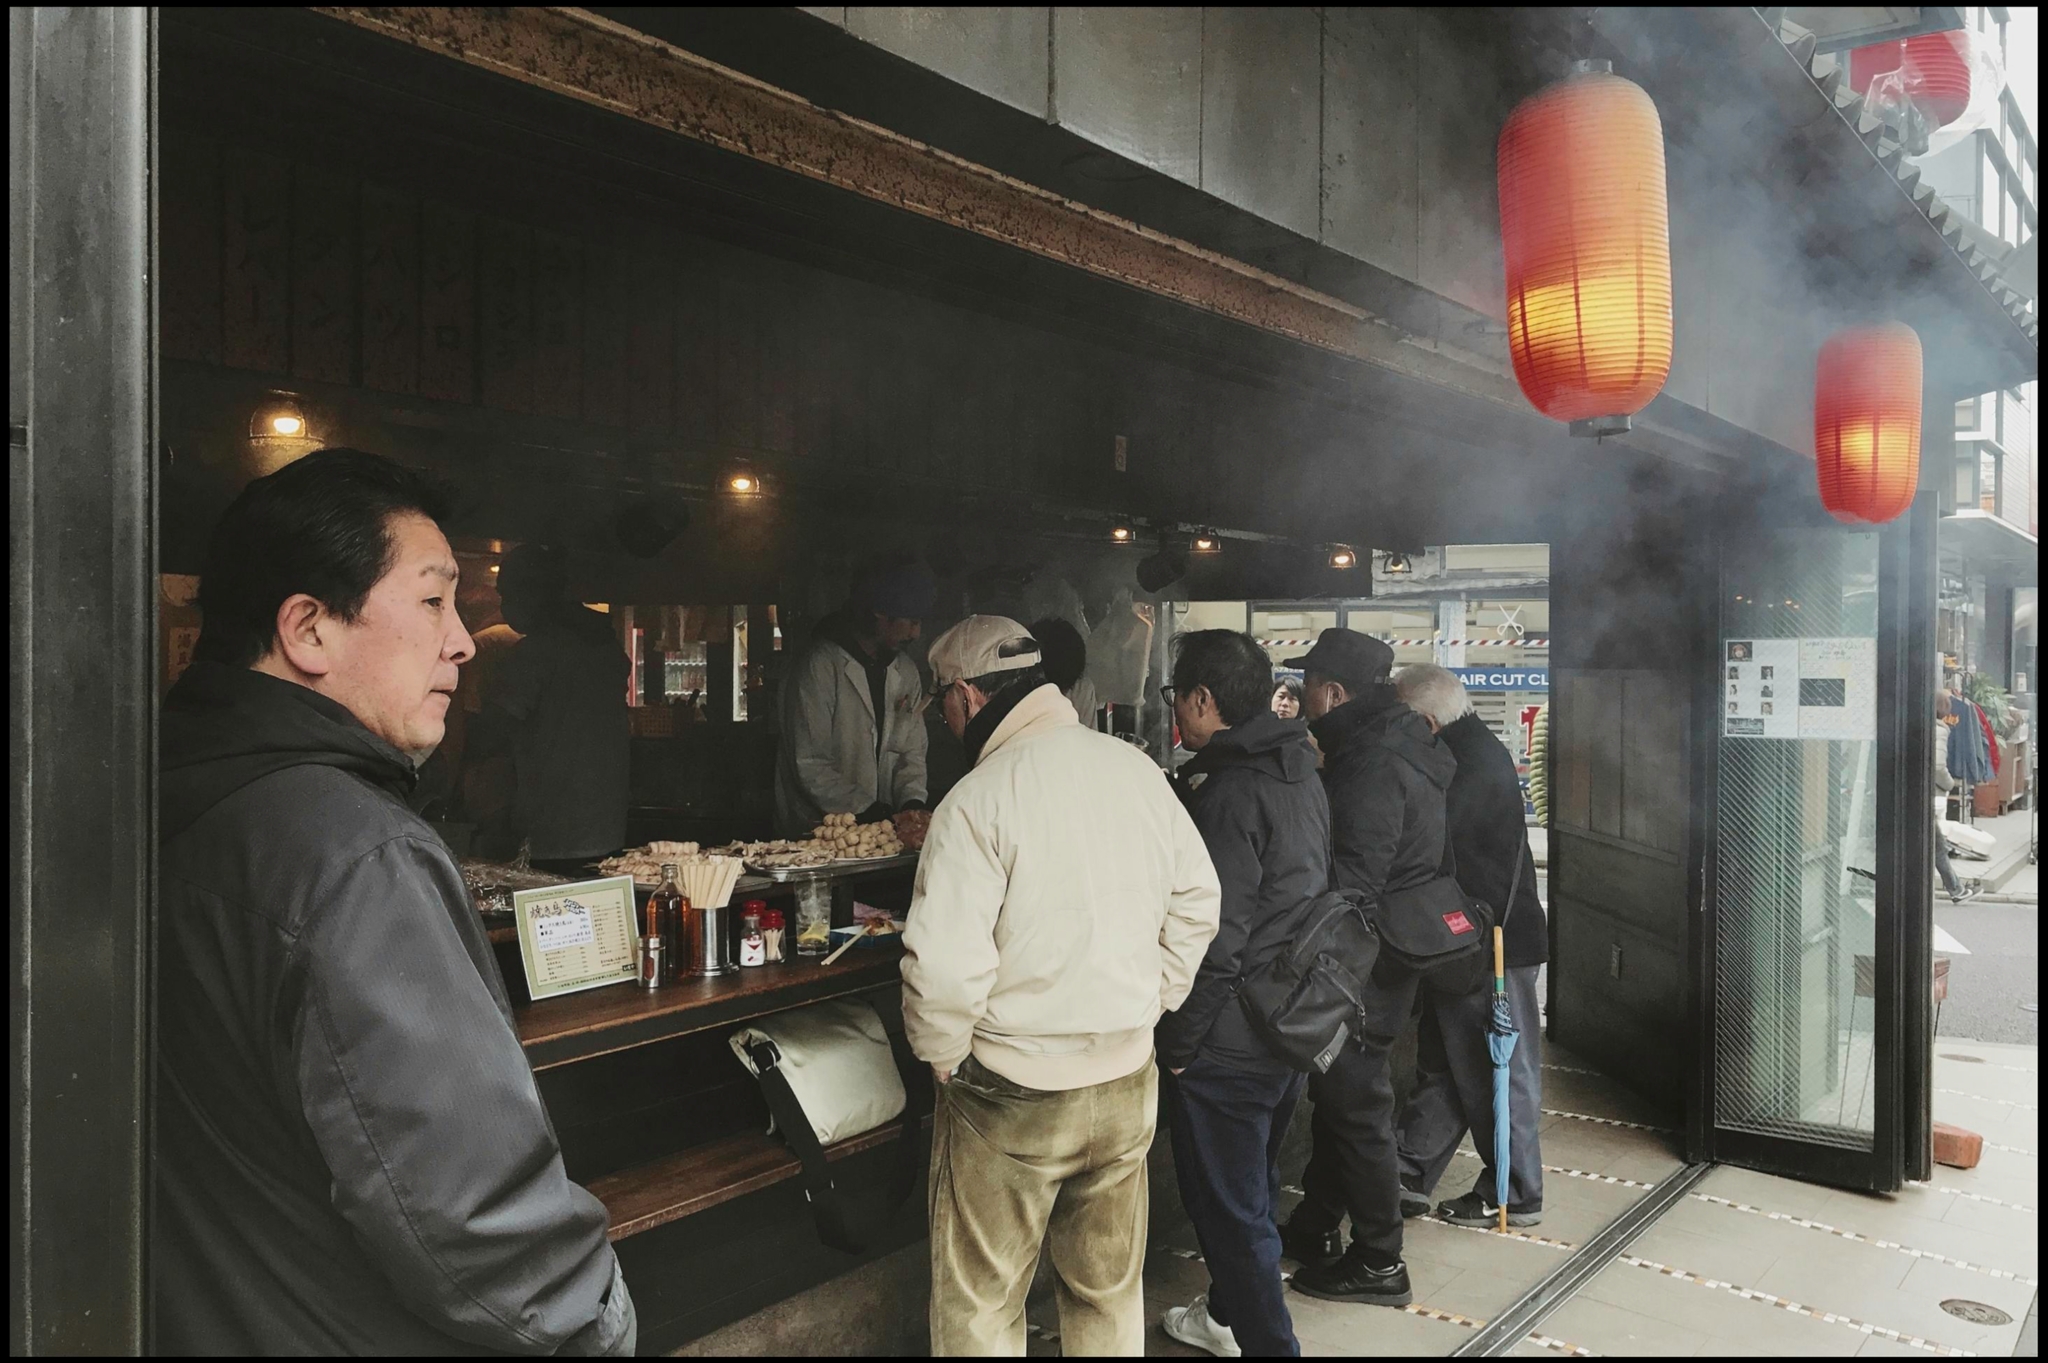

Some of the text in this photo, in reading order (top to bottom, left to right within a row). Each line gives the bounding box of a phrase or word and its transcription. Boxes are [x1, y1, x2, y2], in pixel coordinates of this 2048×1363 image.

[1455, 673, 1486, 685] AIR
[1489, 673, 1525, 686] CUT
[530, 901, 562, 919] 焼き鳥
